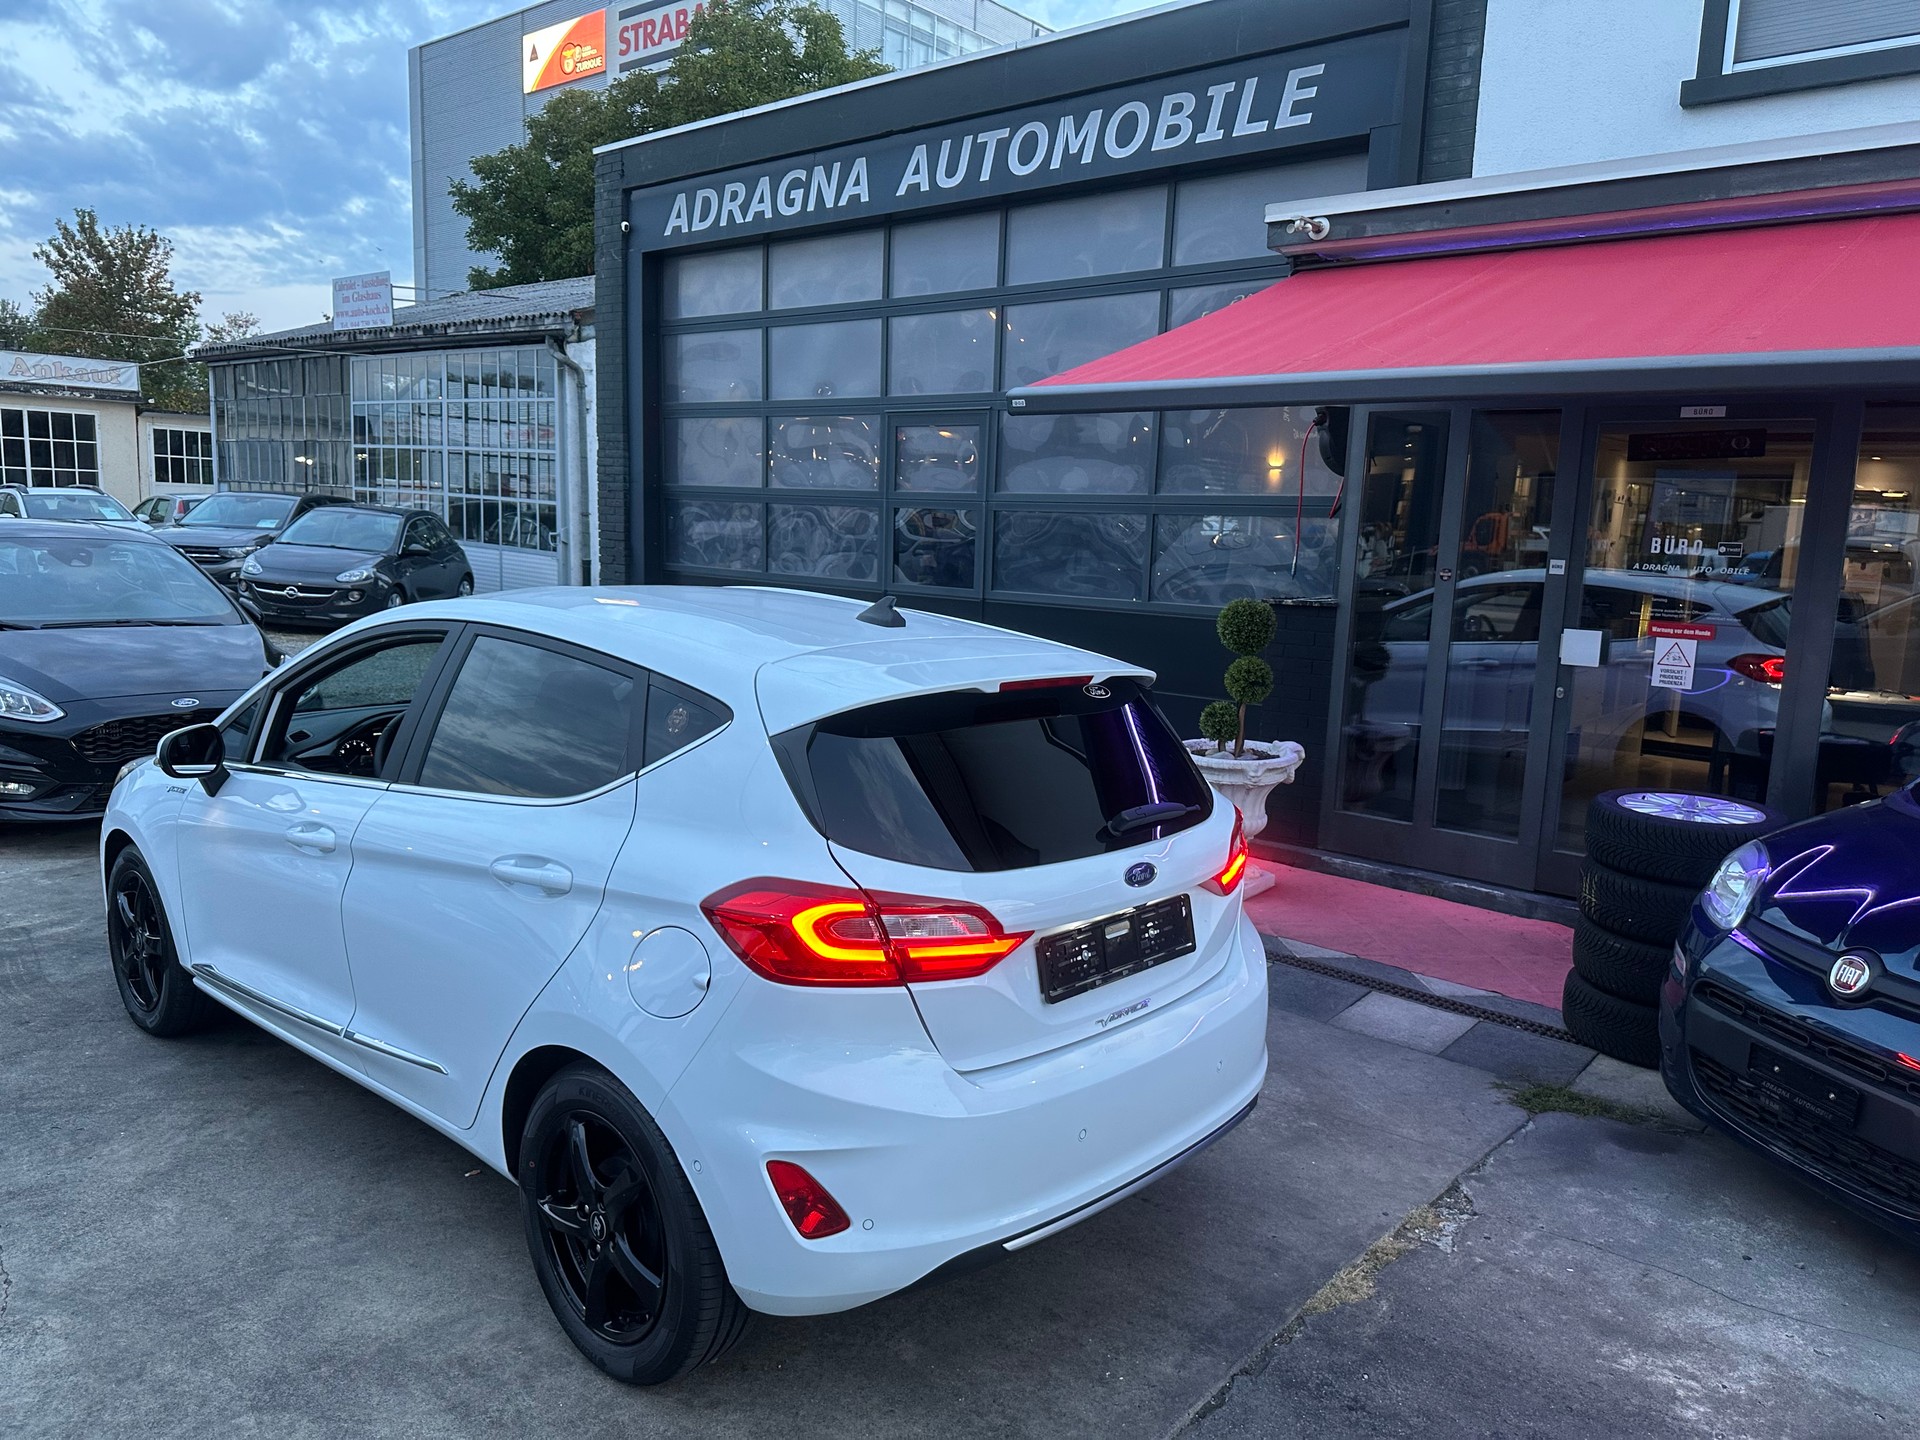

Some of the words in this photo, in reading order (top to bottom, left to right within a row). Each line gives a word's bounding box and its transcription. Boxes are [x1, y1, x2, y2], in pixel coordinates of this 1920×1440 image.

[618, 1, 716, 56] STRAB
[576, 56, 603, 72] ZURIQUE
[664, 157, 870, 236] ADRAGNA
[896, 63, 1326, 196] AUTOMOBILE
[352, 290, 382, 302] Glashaus
[9, 357, 121, 384] Ankauf
[1650, 535, 1703, 555] BÜRO
[1652, 626, 1673, 634] Warnung
[1837, 964, 1863, 986] FIAT
